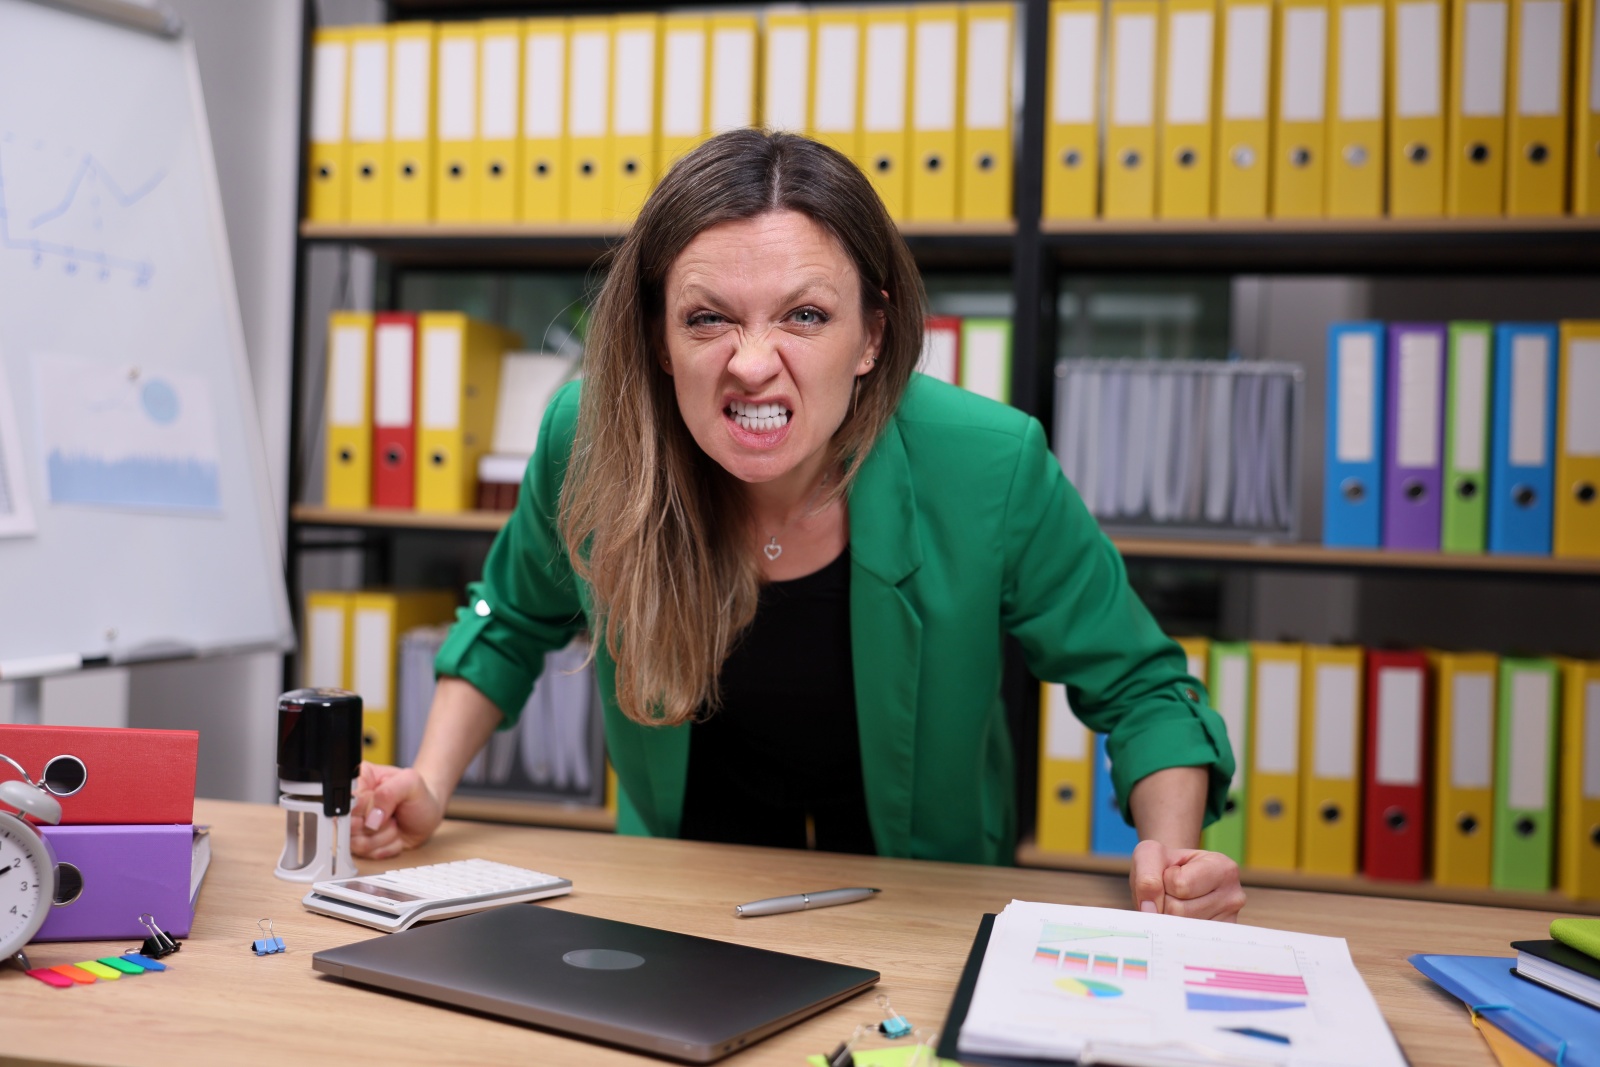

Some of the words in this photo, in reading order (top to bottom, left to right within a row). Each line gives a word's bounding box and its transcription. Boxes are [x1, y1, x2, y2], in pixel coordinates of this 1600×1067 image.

[13, 857, 21, 868] 2
[21, 880, 28, 891] 3
[9, 904, 17, 915] 4
